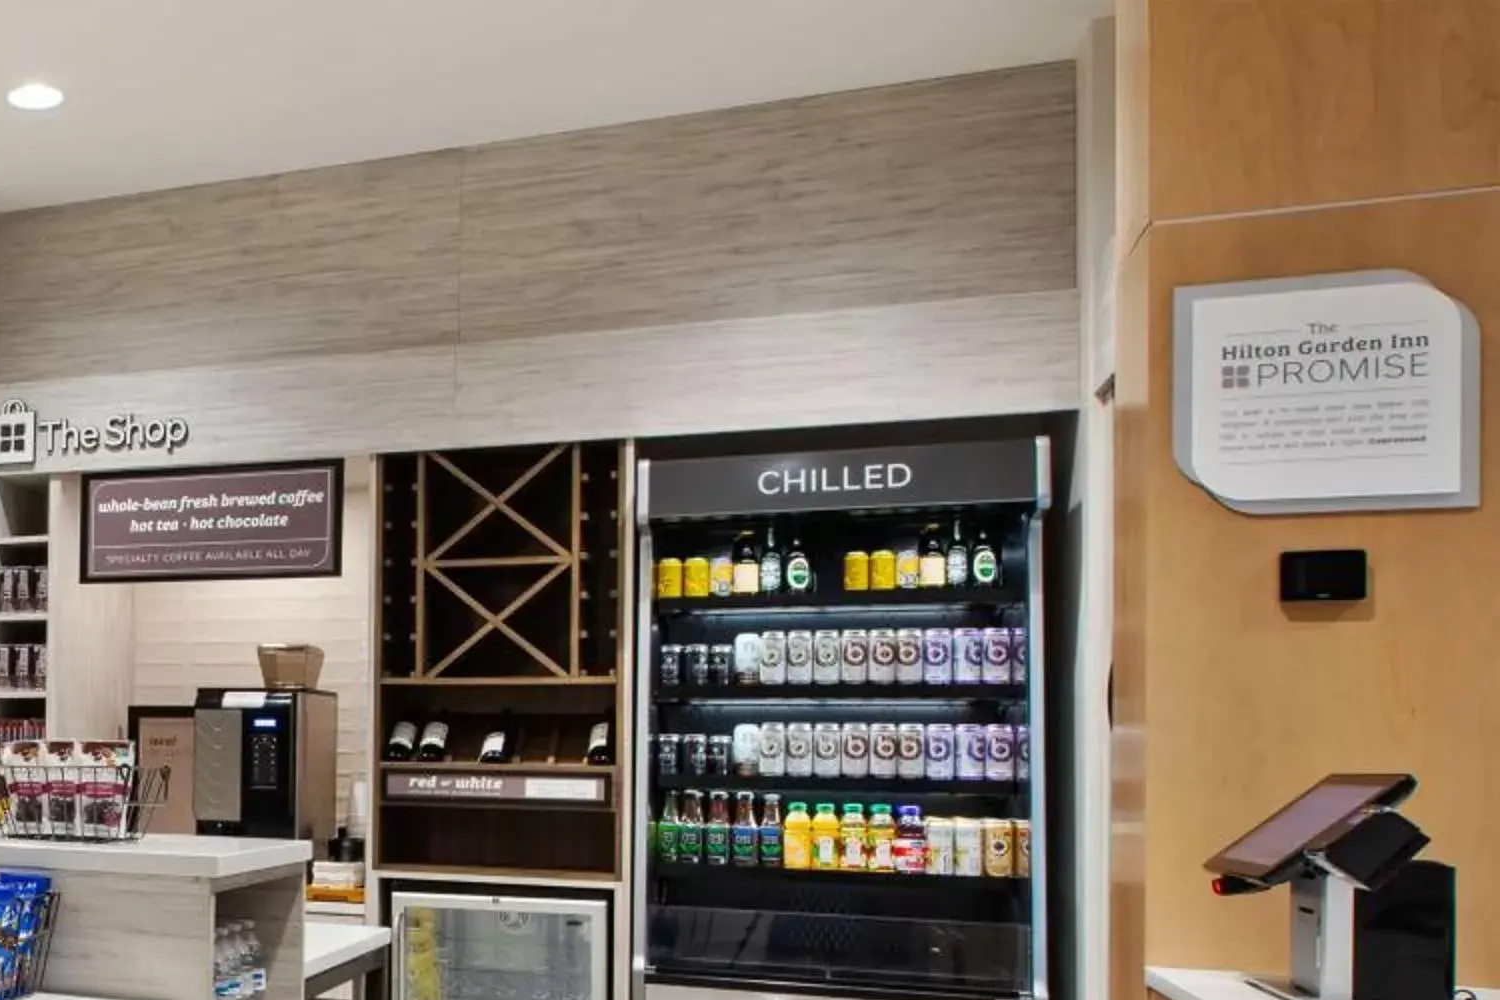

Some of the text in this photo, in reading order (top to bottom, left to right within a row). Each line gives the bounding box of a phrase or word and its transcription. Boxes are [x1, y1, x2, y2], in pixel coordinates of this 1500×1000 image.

[1221, 333, 1429, 361] Hilton Garden Inn
[1256, 351, 1429, 388] PROMISE
[38, 413, 189, 456] The Shop
[757, 463, 912, 495] CHILLED
[177, 492, 218, 513] fresh
[221, 490, 276, 508] brewed
[278, 488, 325, 507] coffee
[130, 513, 289, 534] hot tea hot chocolate
[162, 552, 201, 563] COFFEE
[408, 775, 437, 789] red
[454, 775, 503, 789] white
